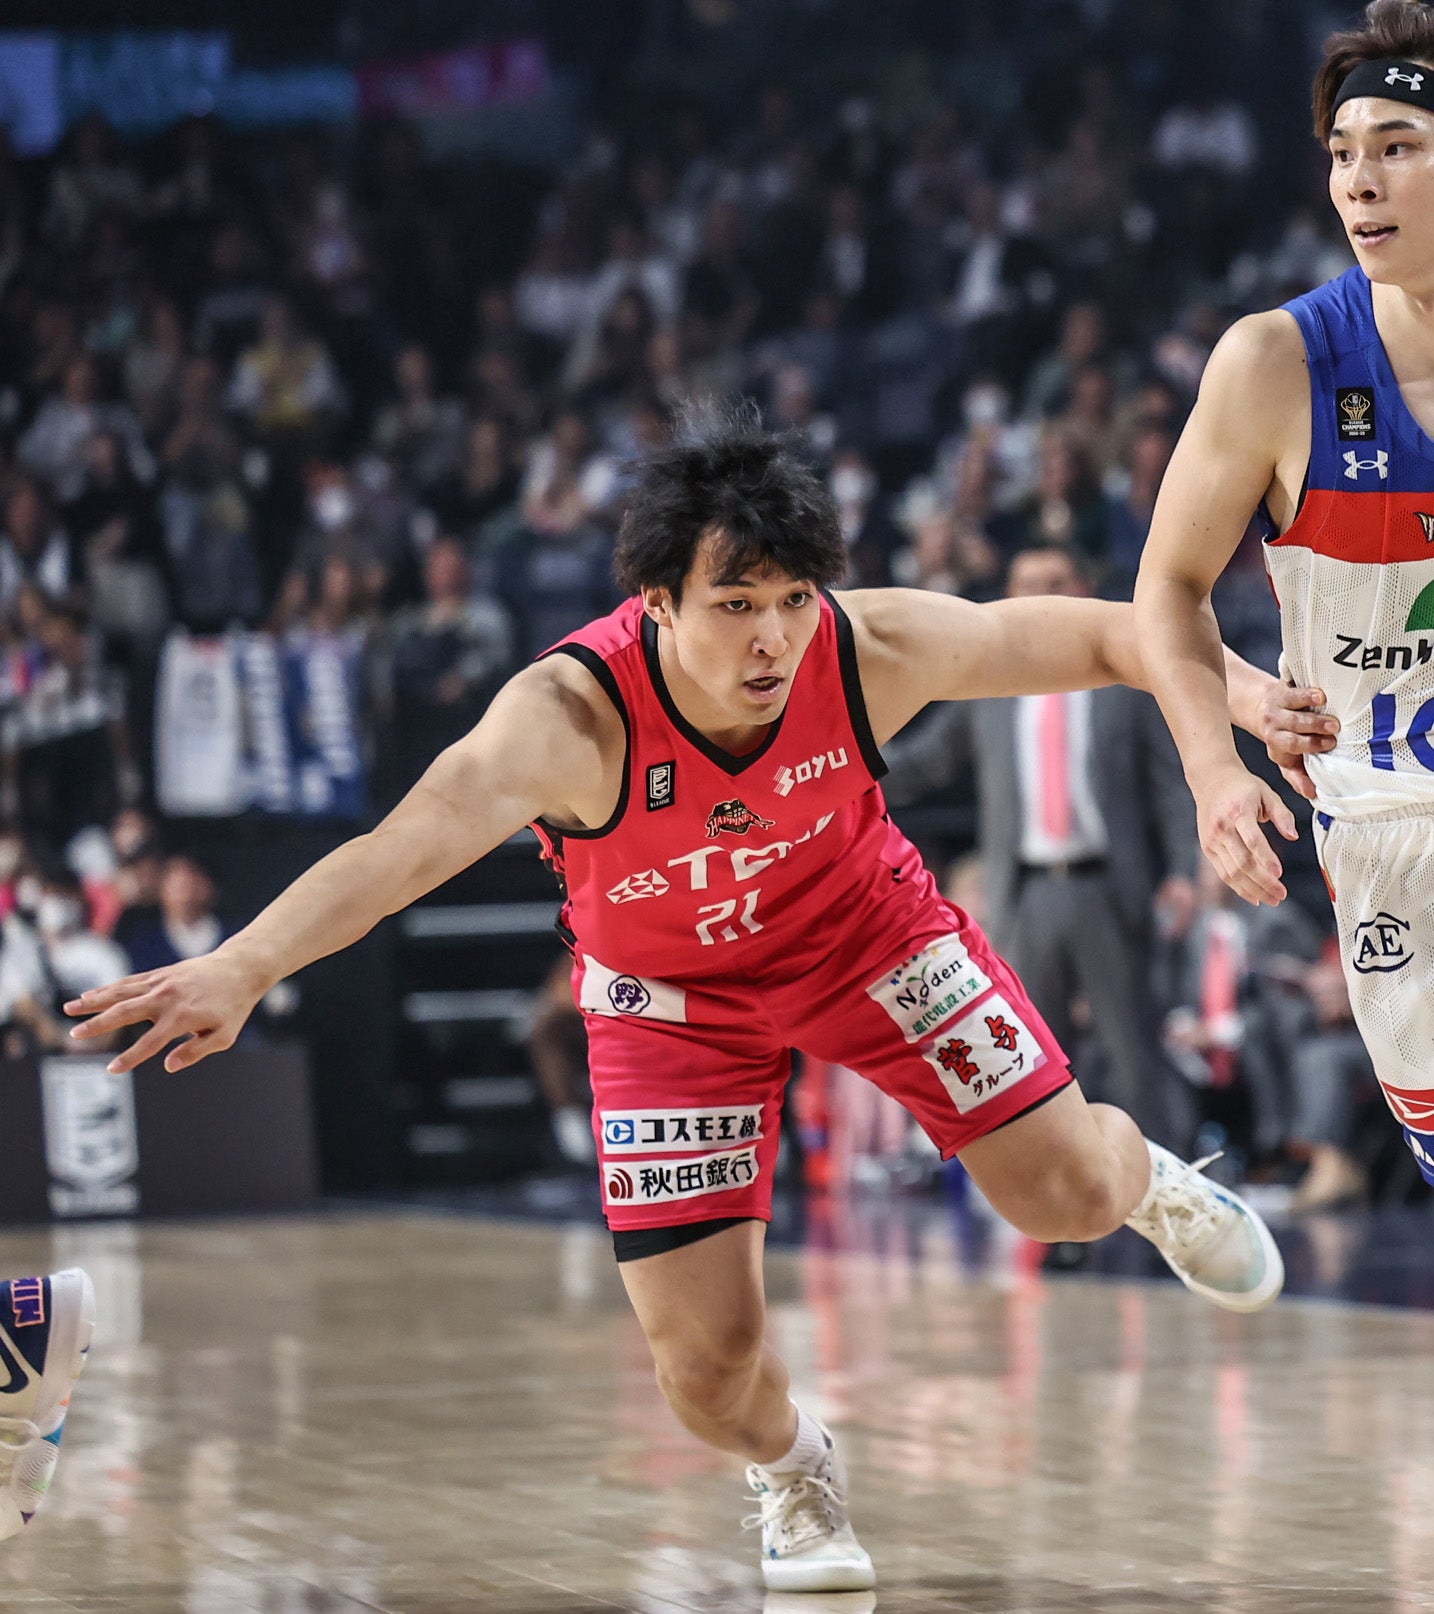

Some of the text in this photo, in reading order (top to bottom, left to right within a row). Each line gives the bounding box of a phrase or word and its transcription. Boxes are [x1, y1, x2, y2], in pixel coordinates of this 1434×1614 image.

[773, 746, 849, 798] SOYU
[639, 1151, 753, 1198] 秋田銀行
